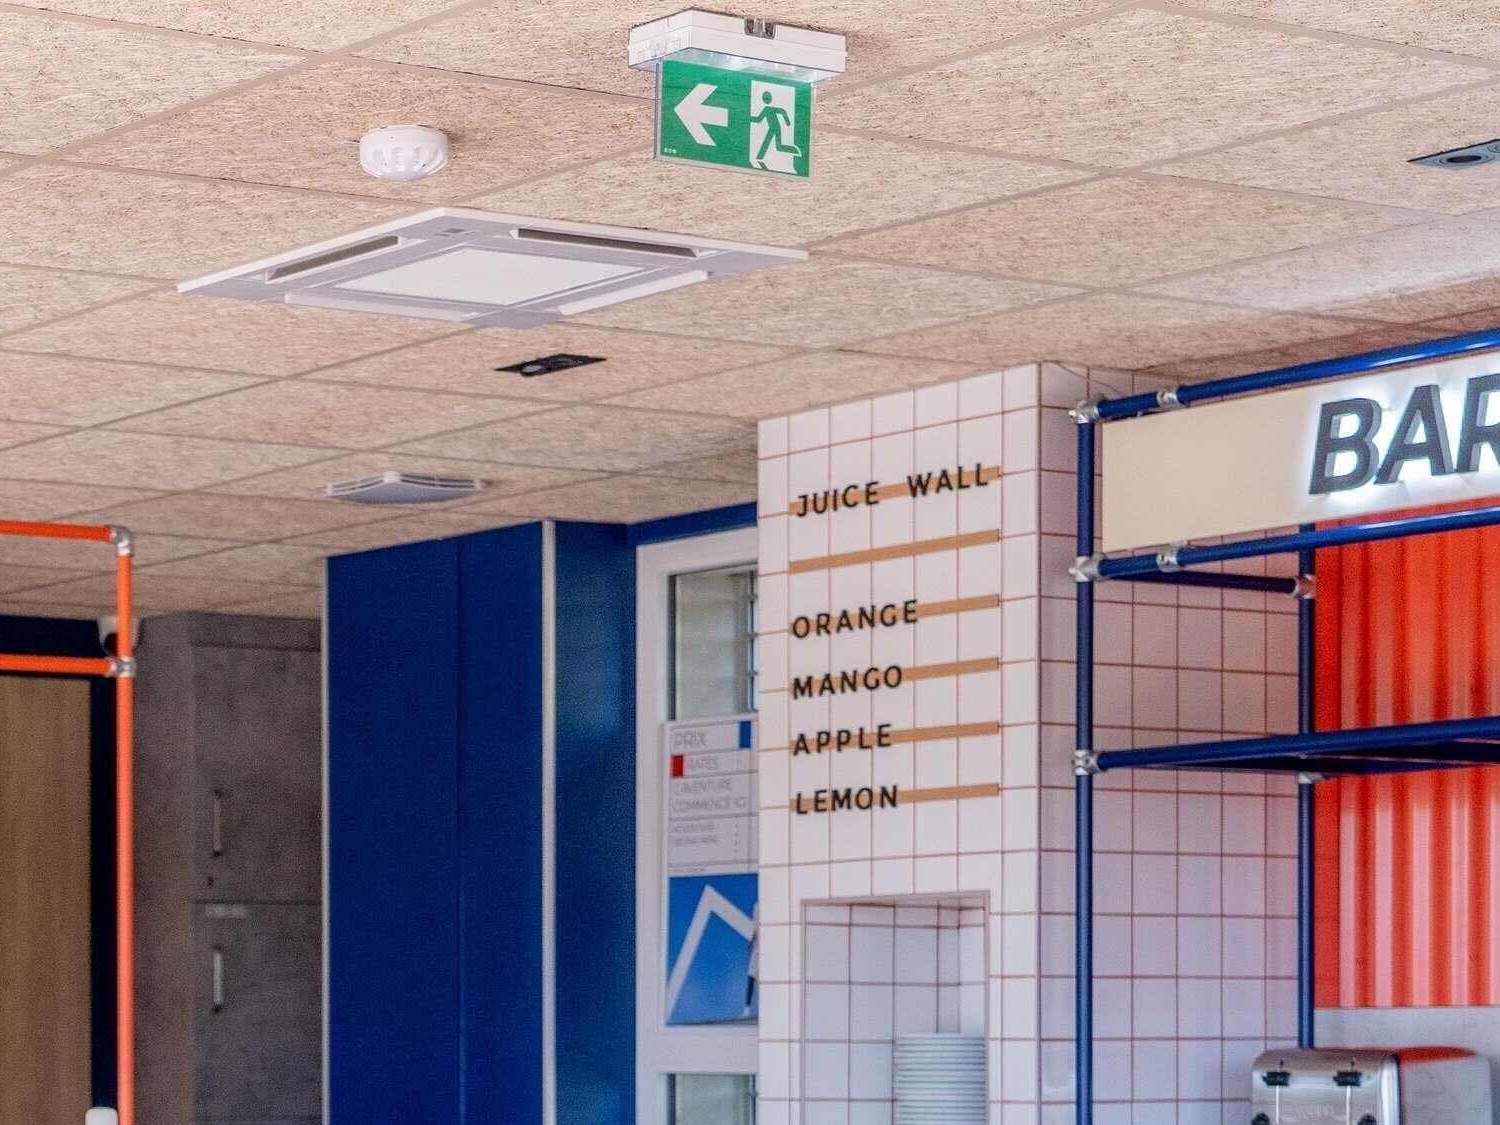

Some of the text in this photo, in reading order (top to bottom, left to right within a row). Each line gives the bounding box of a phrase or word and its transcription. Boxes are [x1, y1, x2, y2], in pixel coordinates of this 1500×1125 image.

[1309, 373, 1500, 495] BAR
[796, 463, 989, 518] JUICE WALL
[791, 599, 918, 640] ORANGE
[792, 665, 902, 700] MANGO
[792, 724, 892, 757] APPLE
[796, 785, 898, 815] LEMON
